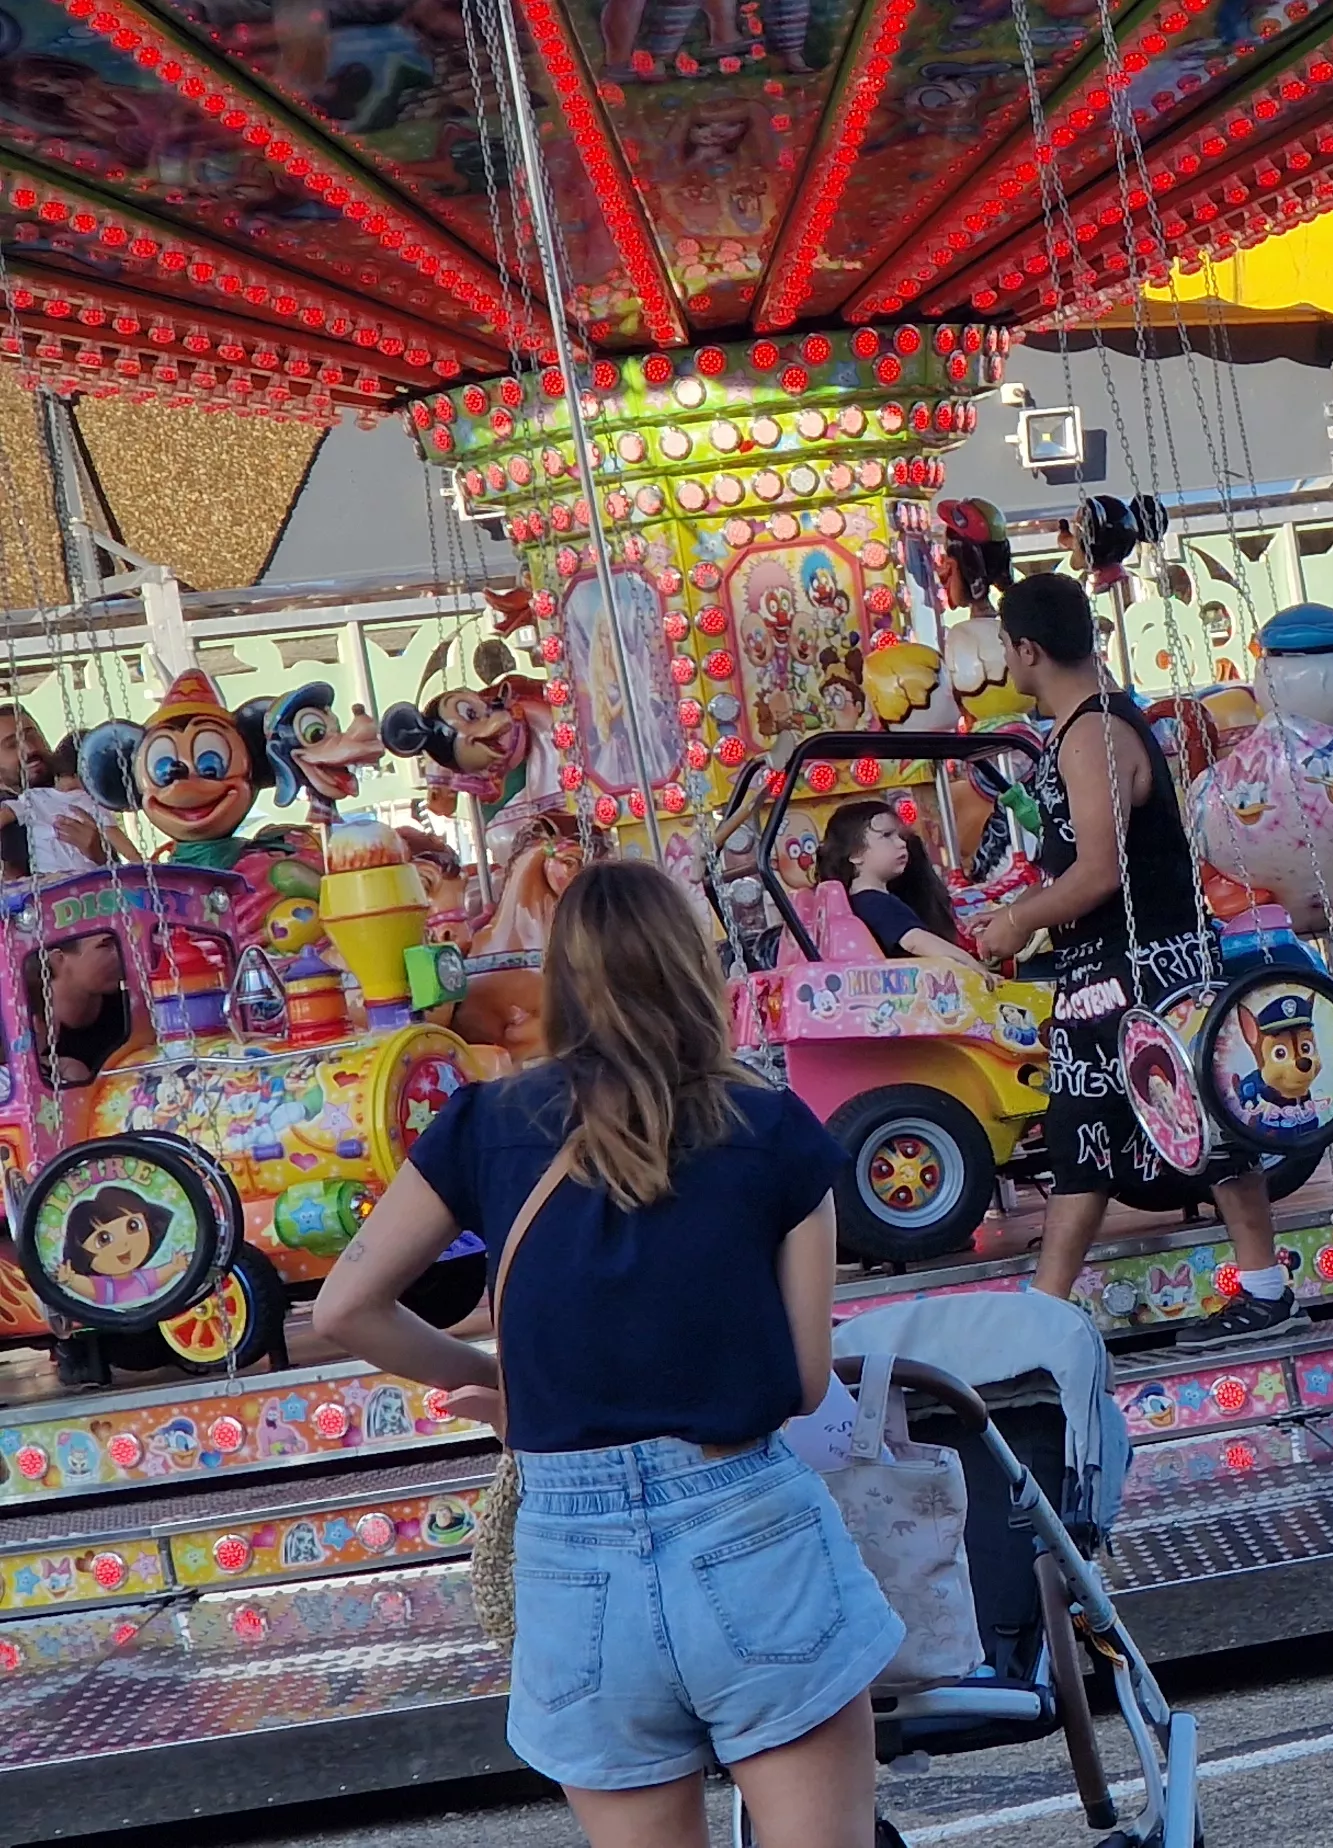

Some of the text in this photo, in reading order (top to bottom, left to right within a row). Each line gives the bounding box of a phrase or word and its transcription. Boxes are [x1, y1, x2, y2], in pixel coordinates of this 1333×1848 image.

[53, 887, 193, 929] DISNEY
[847, 967, 920, 997] MICKEY
[43, 1156, 158, 1214] LEIRE
